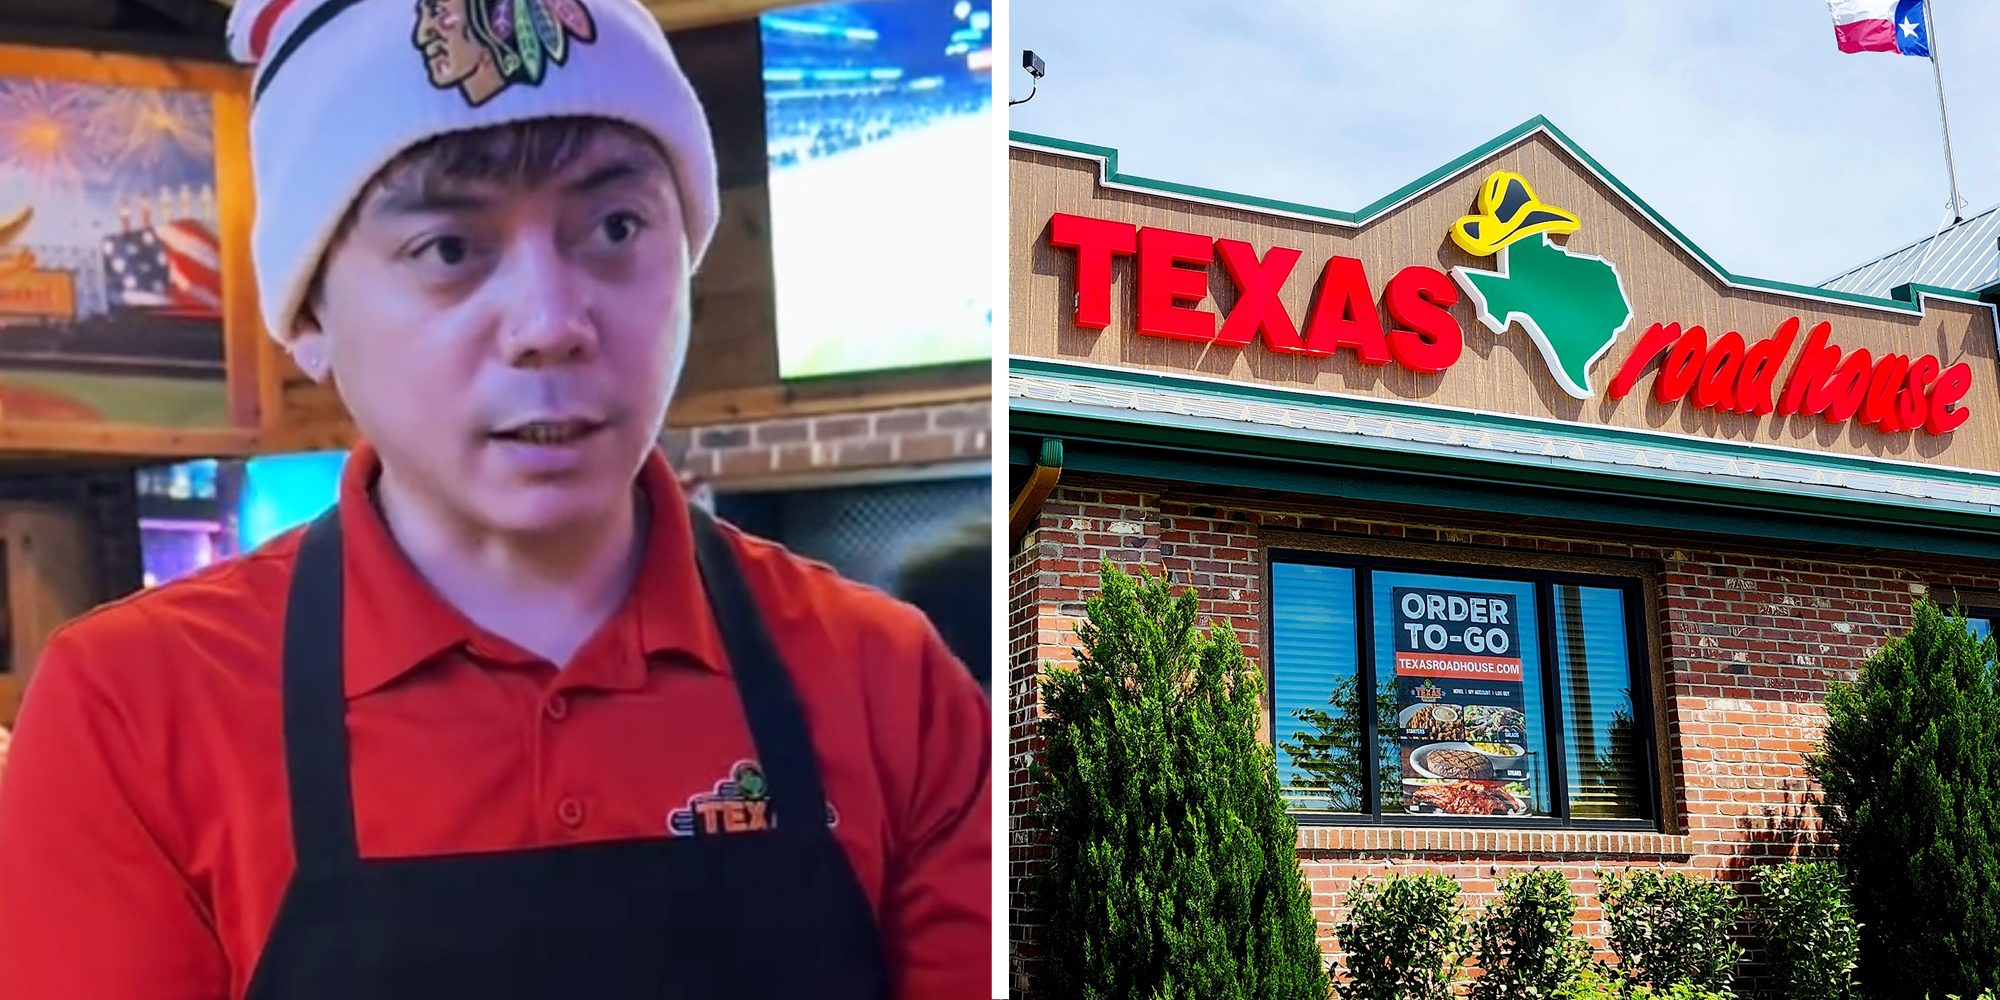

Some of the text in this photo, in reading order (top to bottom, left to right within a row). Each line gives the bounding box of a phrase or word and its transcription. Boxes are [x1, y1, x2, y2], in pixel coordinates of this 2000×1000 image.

[1050, 213, 1463, 373] TEXAS
[1401, 592, 1510, 625] ORDER
[1404, 622, 1510, 655] TO-GO
[1398, 658, 1520, 675] TEXASROADHOUSE.COM
[1415, 687, 1442, 698] TEXAS
